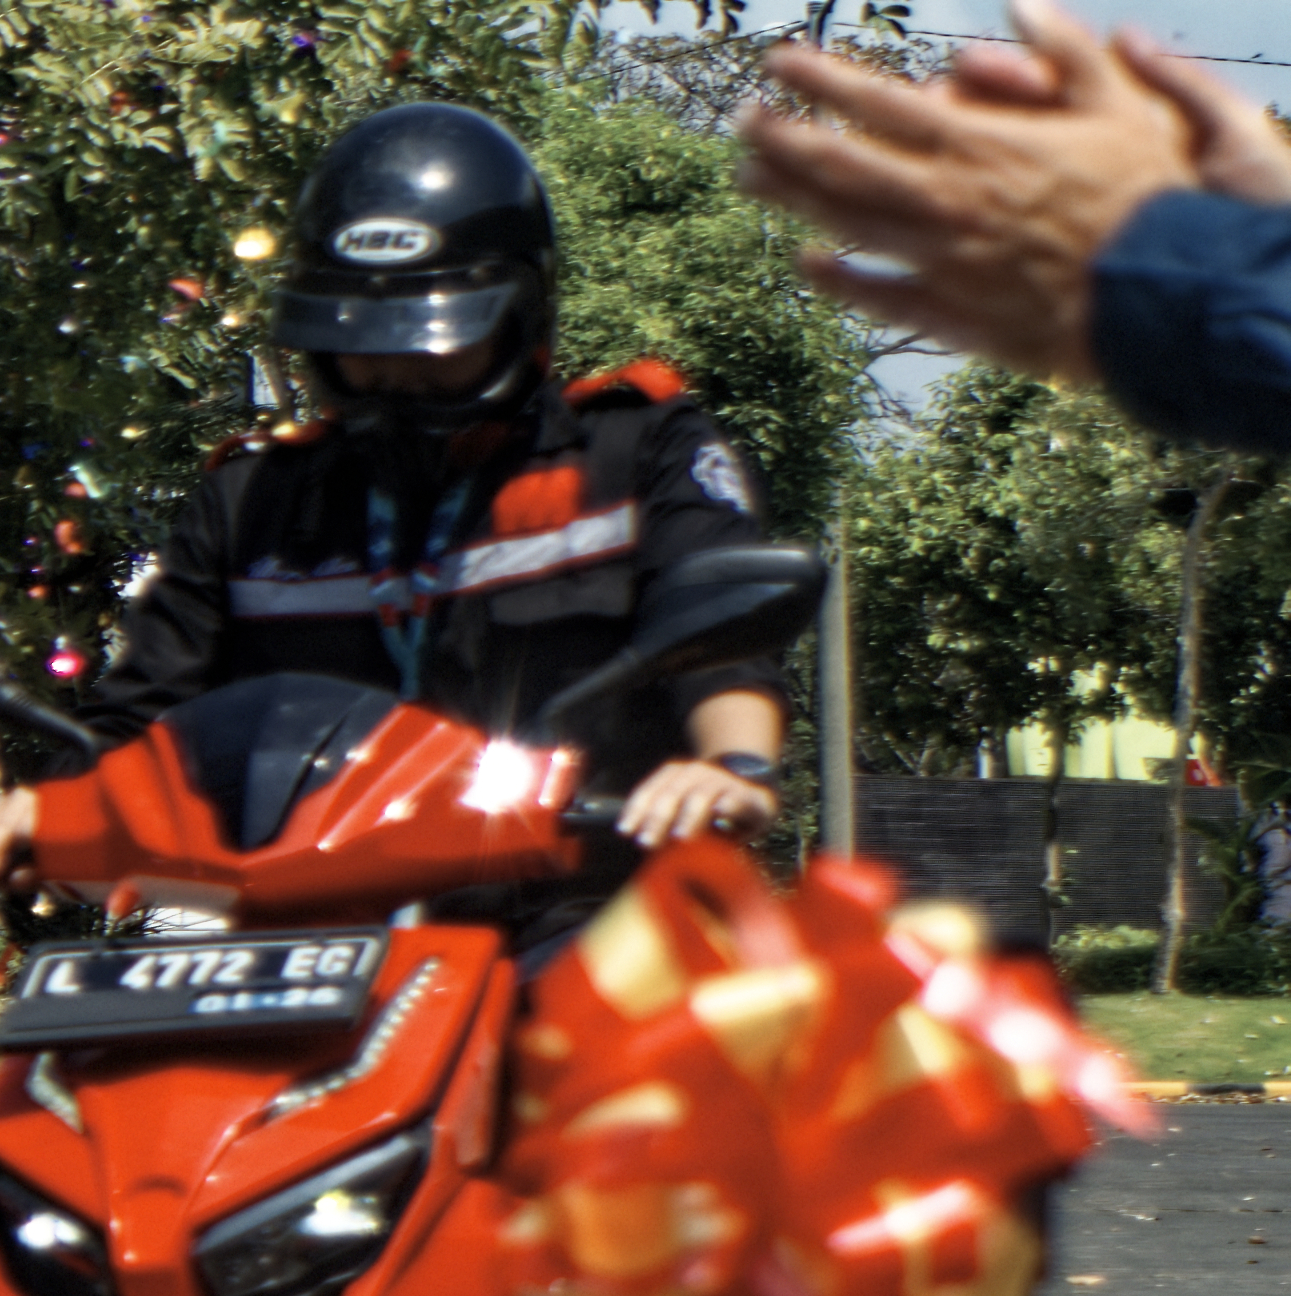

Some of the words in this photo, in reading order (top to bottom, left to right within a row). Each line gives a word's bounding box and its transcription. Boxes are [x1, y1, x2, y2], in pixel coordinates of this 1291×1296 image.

[43, 960, 80, 994] L
[118, 951, 255, 989] 4772
[280, 946, 354, 978] EG
